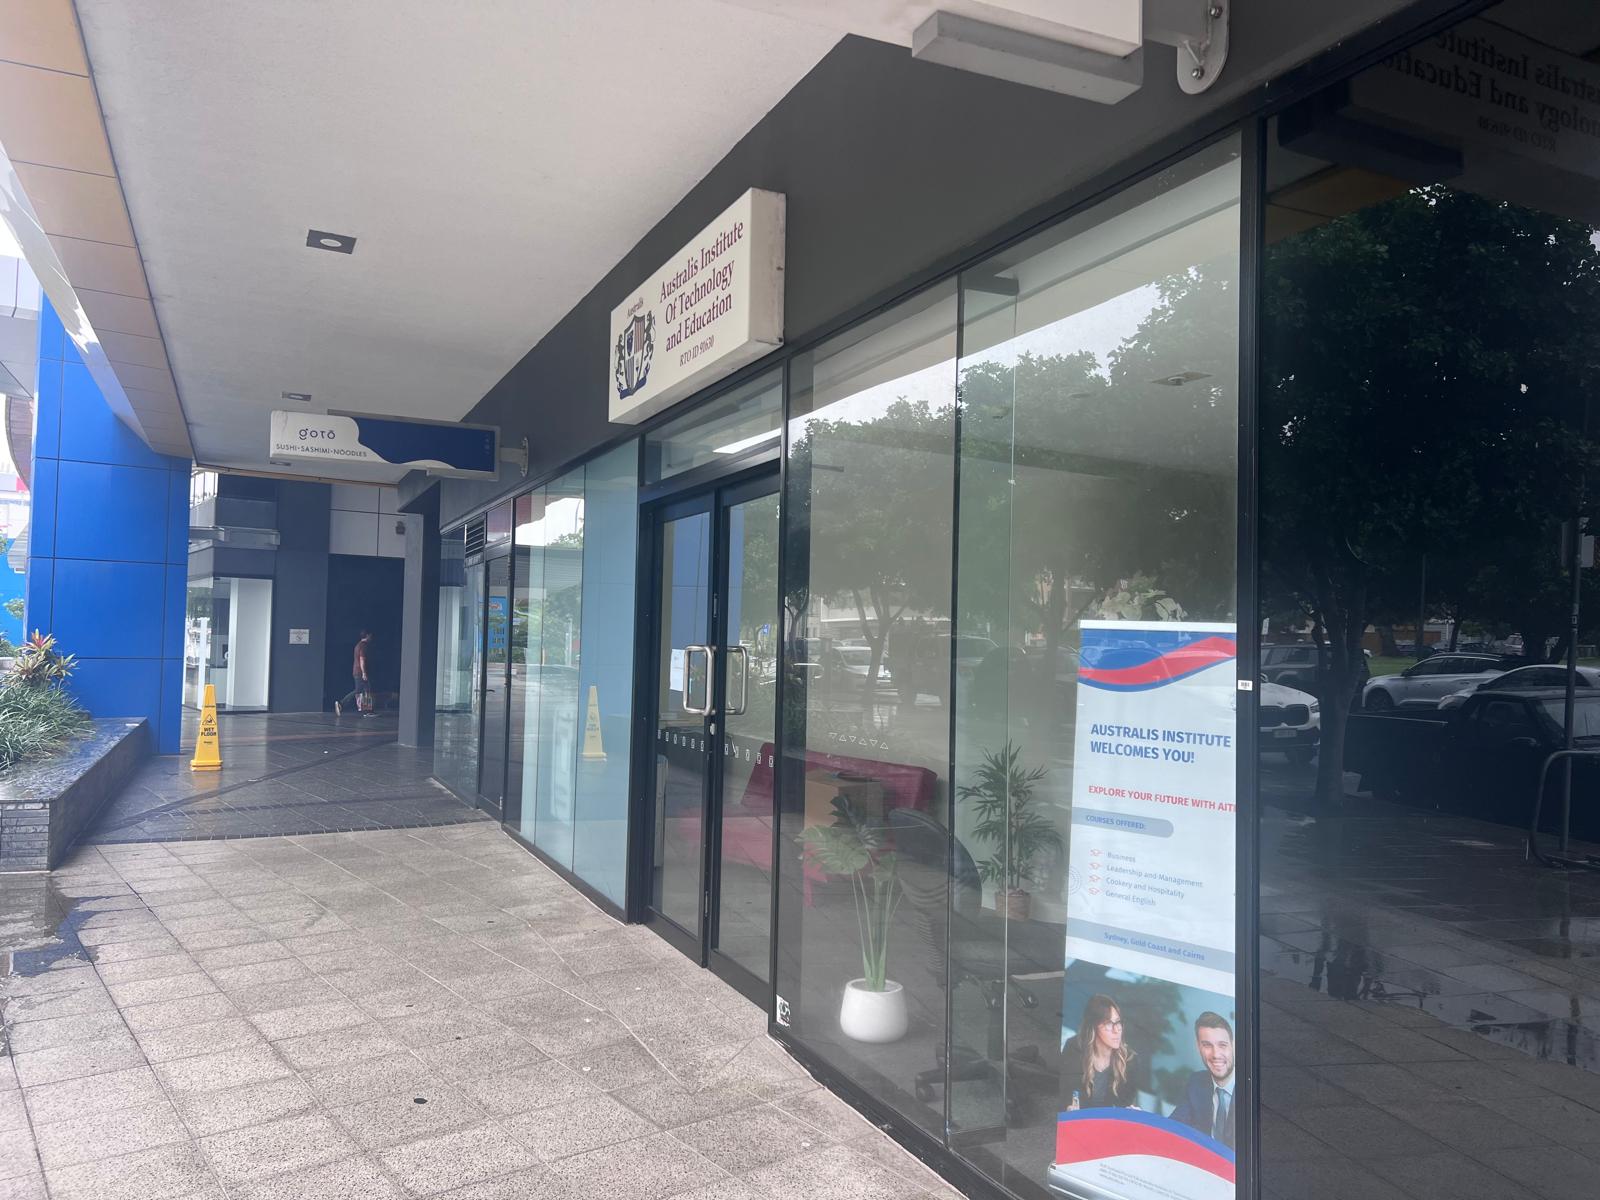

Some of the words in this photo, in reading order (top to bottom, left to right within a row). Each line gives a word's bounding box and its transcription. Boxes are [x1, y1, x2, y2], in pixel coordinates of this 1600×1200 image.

[659, 257, 698, 303] Australis
[700, 221, 744, 270] Institute
[665, 294, 679, 325] Of
[679, 260, 735, 313] Technology
[665, 330, 682, 352] and
[684, 293, 732, 341] Education
[679, 349, 692, 367] RTO
[692, 344, 699, 360] ID
[1091, 723, 1159, 741] AUSTRALIS
[1162, 730, 1231, 748] INSTITUTE
[1090, 740, 1159, 760] WELCOMES
[1163, 748, 1195, 764] YOU!
[1088, 785, 1126, 798] EXPLORE
[1127, 789, 1153, 802] YOUR
[1154, 792, 1190, 807] FUTURE
[1191, 798, 1216, 811] WITH
[1086, 815, 1115, 825] COURSES
[1107, 851, 1136, 863] Business
[1106, 864, 1143, 877] Leadership
[1143, 872, 1157, 880] and
[1158, 873, 1204, 888] Management
[1105, 890, 1131, 901] General
[1132, 896, 1156, 906] English
[1106, 877, 1132, 889] Cookery
[1133, 883, 1147, 891] and
[1148, 886, 1185, 900] Hospitality
[1104, 932, 1130, 945] Sydney,
[1130, 937, 1146, 947] Gold
[1147, 941, 1167, 952] Coast
[1168, 947, 1181, 955] and
[1182, 950, 1205, 961] Cairns
